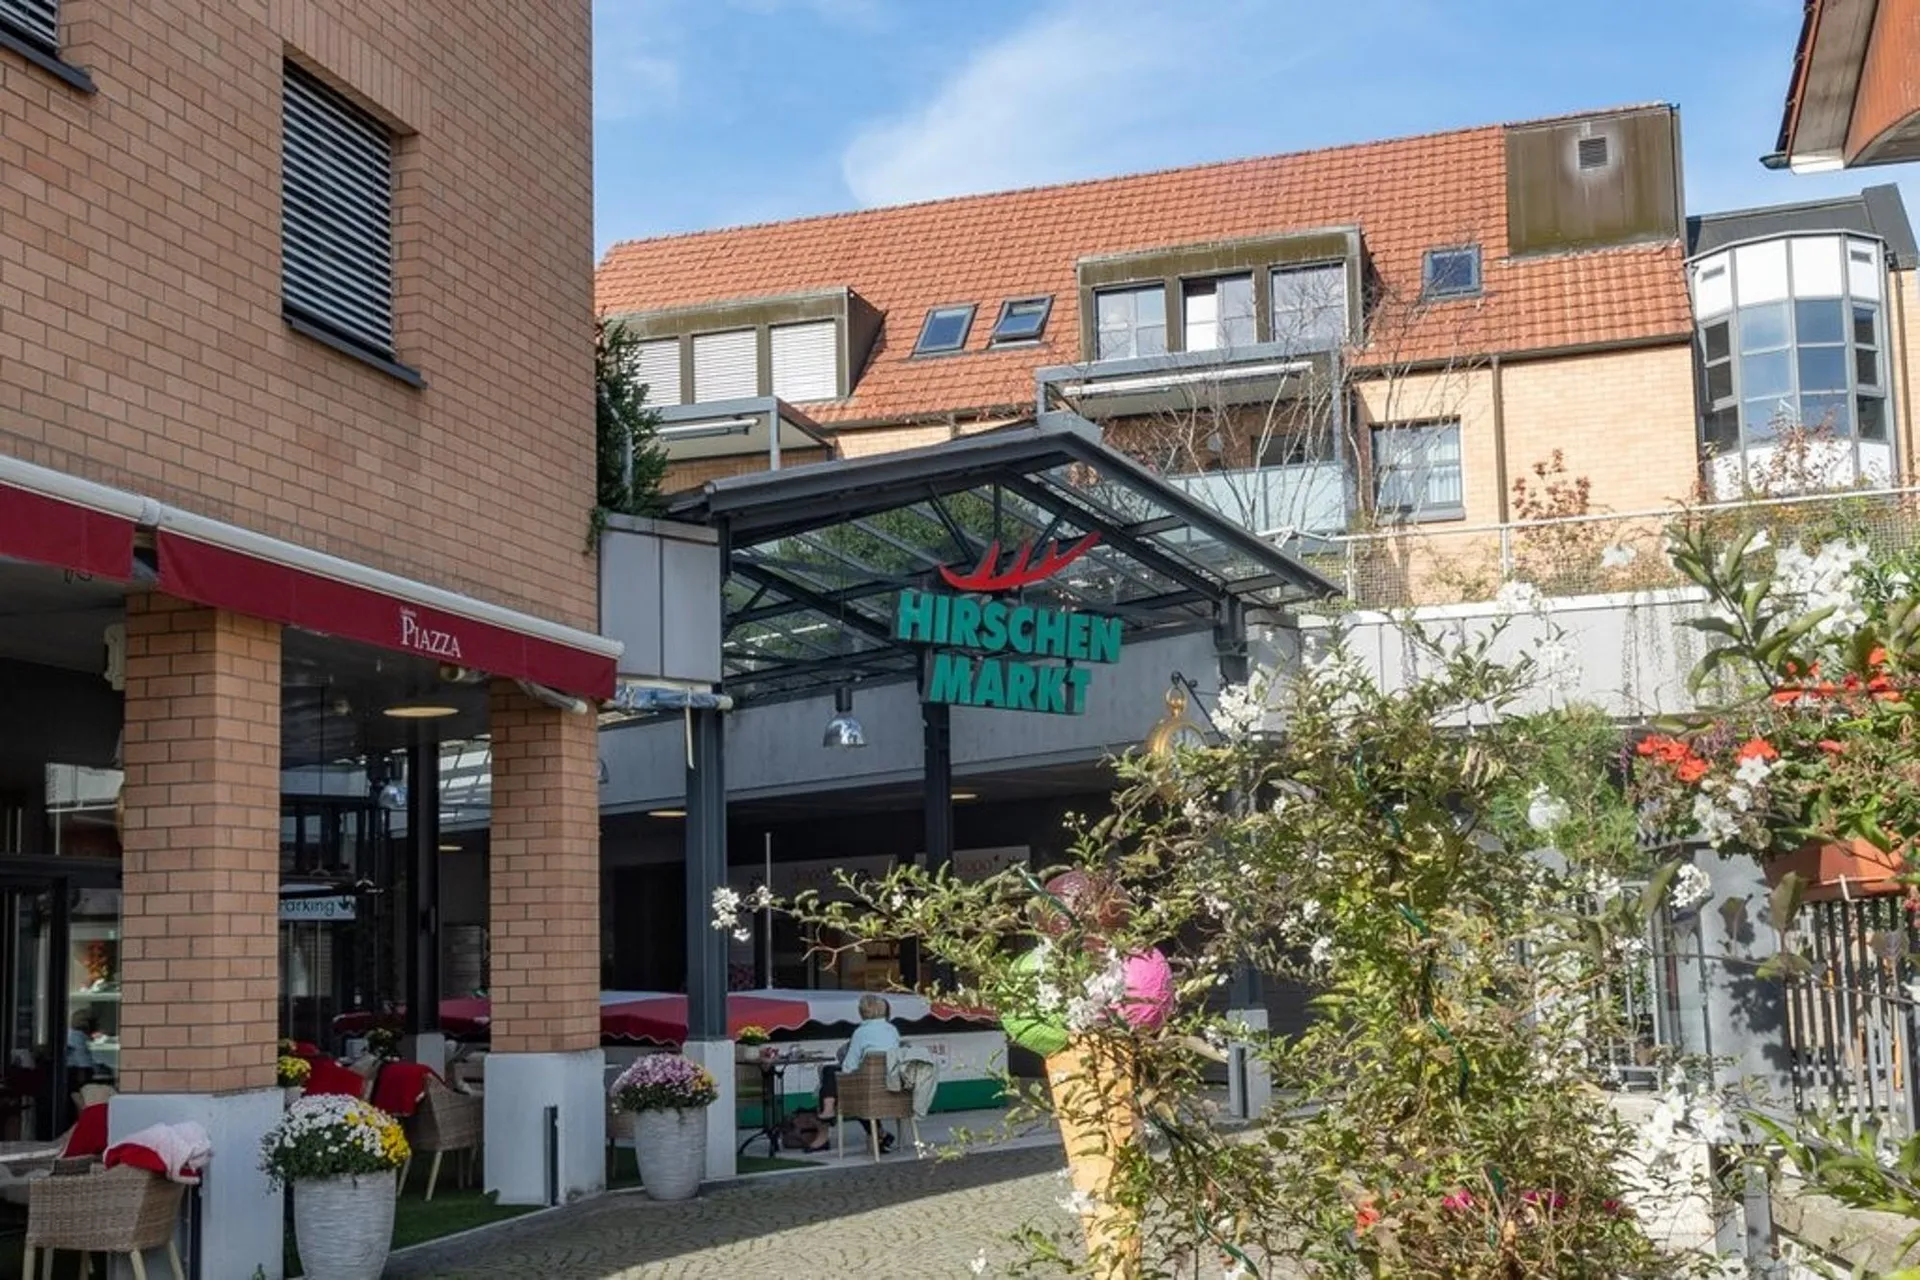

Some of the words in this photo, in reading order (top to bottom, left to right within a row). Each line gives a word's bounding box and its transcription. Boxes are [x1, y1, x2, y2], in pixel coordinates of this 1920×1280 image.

[401, 615, 462, 658] PIAZZA
[897, 588, 1124, 663] HIRSCHEN
[929, 653, 1092, 715] MARKT
[280, 900, 335, 916] arking
